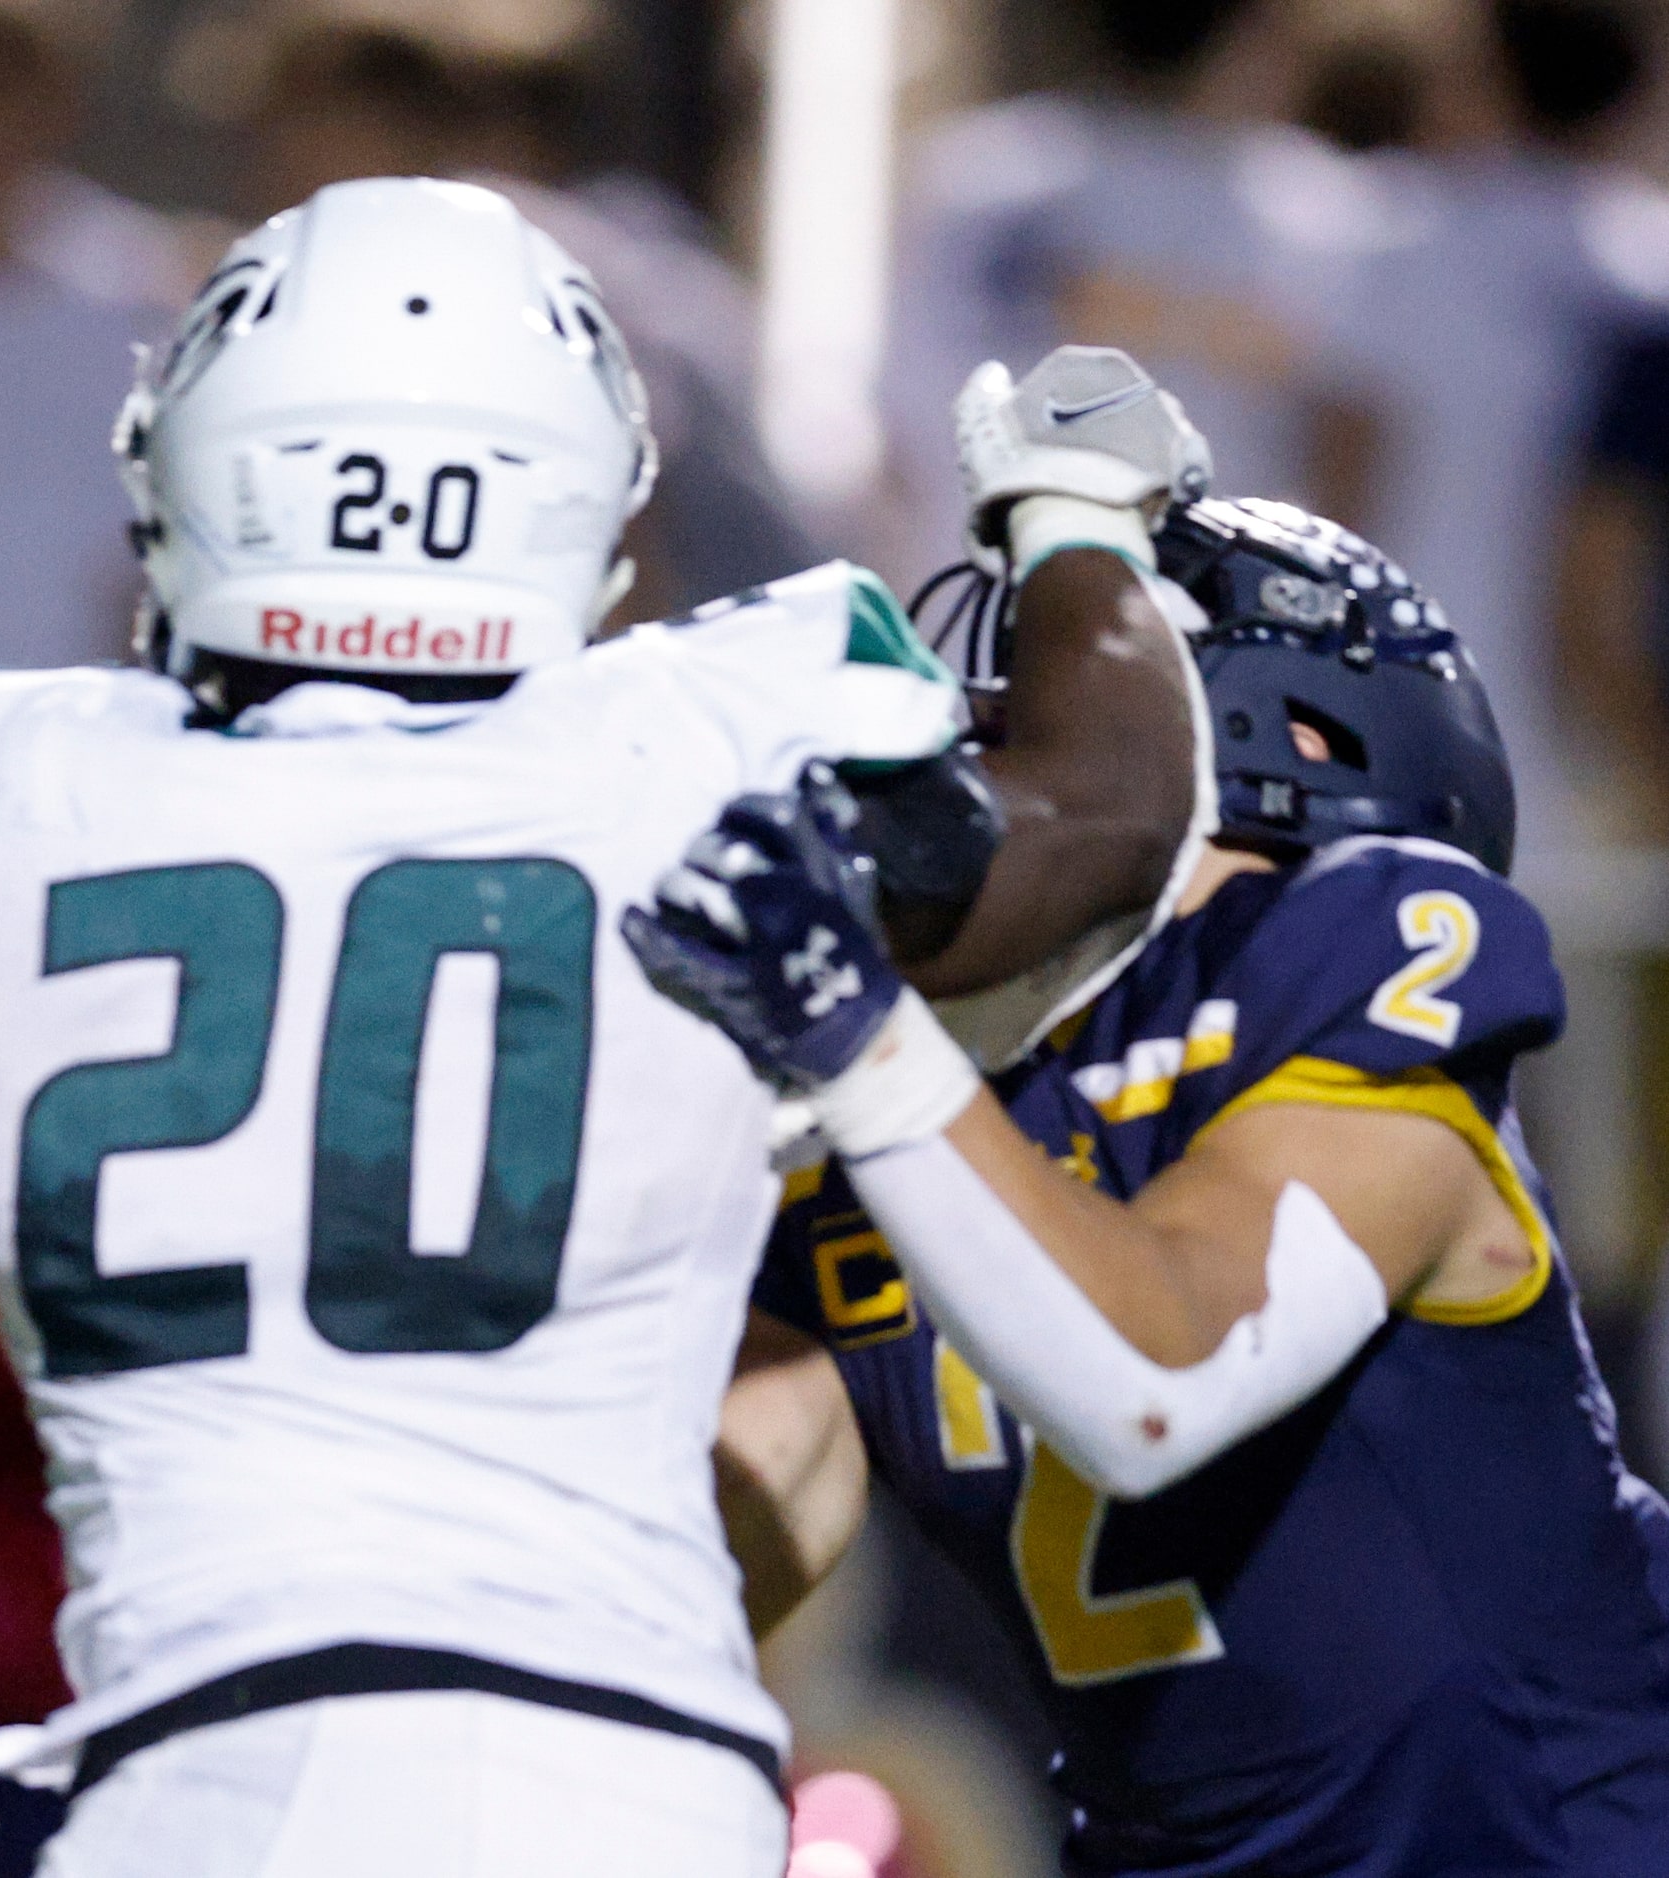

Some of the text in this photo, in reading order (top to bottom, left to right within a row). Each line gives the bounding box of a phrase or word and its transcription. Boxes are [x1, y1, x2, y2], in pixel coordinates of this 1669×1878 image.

[260, 607, 515, 663] Riddell
[1365, 890, 1482, 1049] 2
[14, 856, 598, 1382] 20
